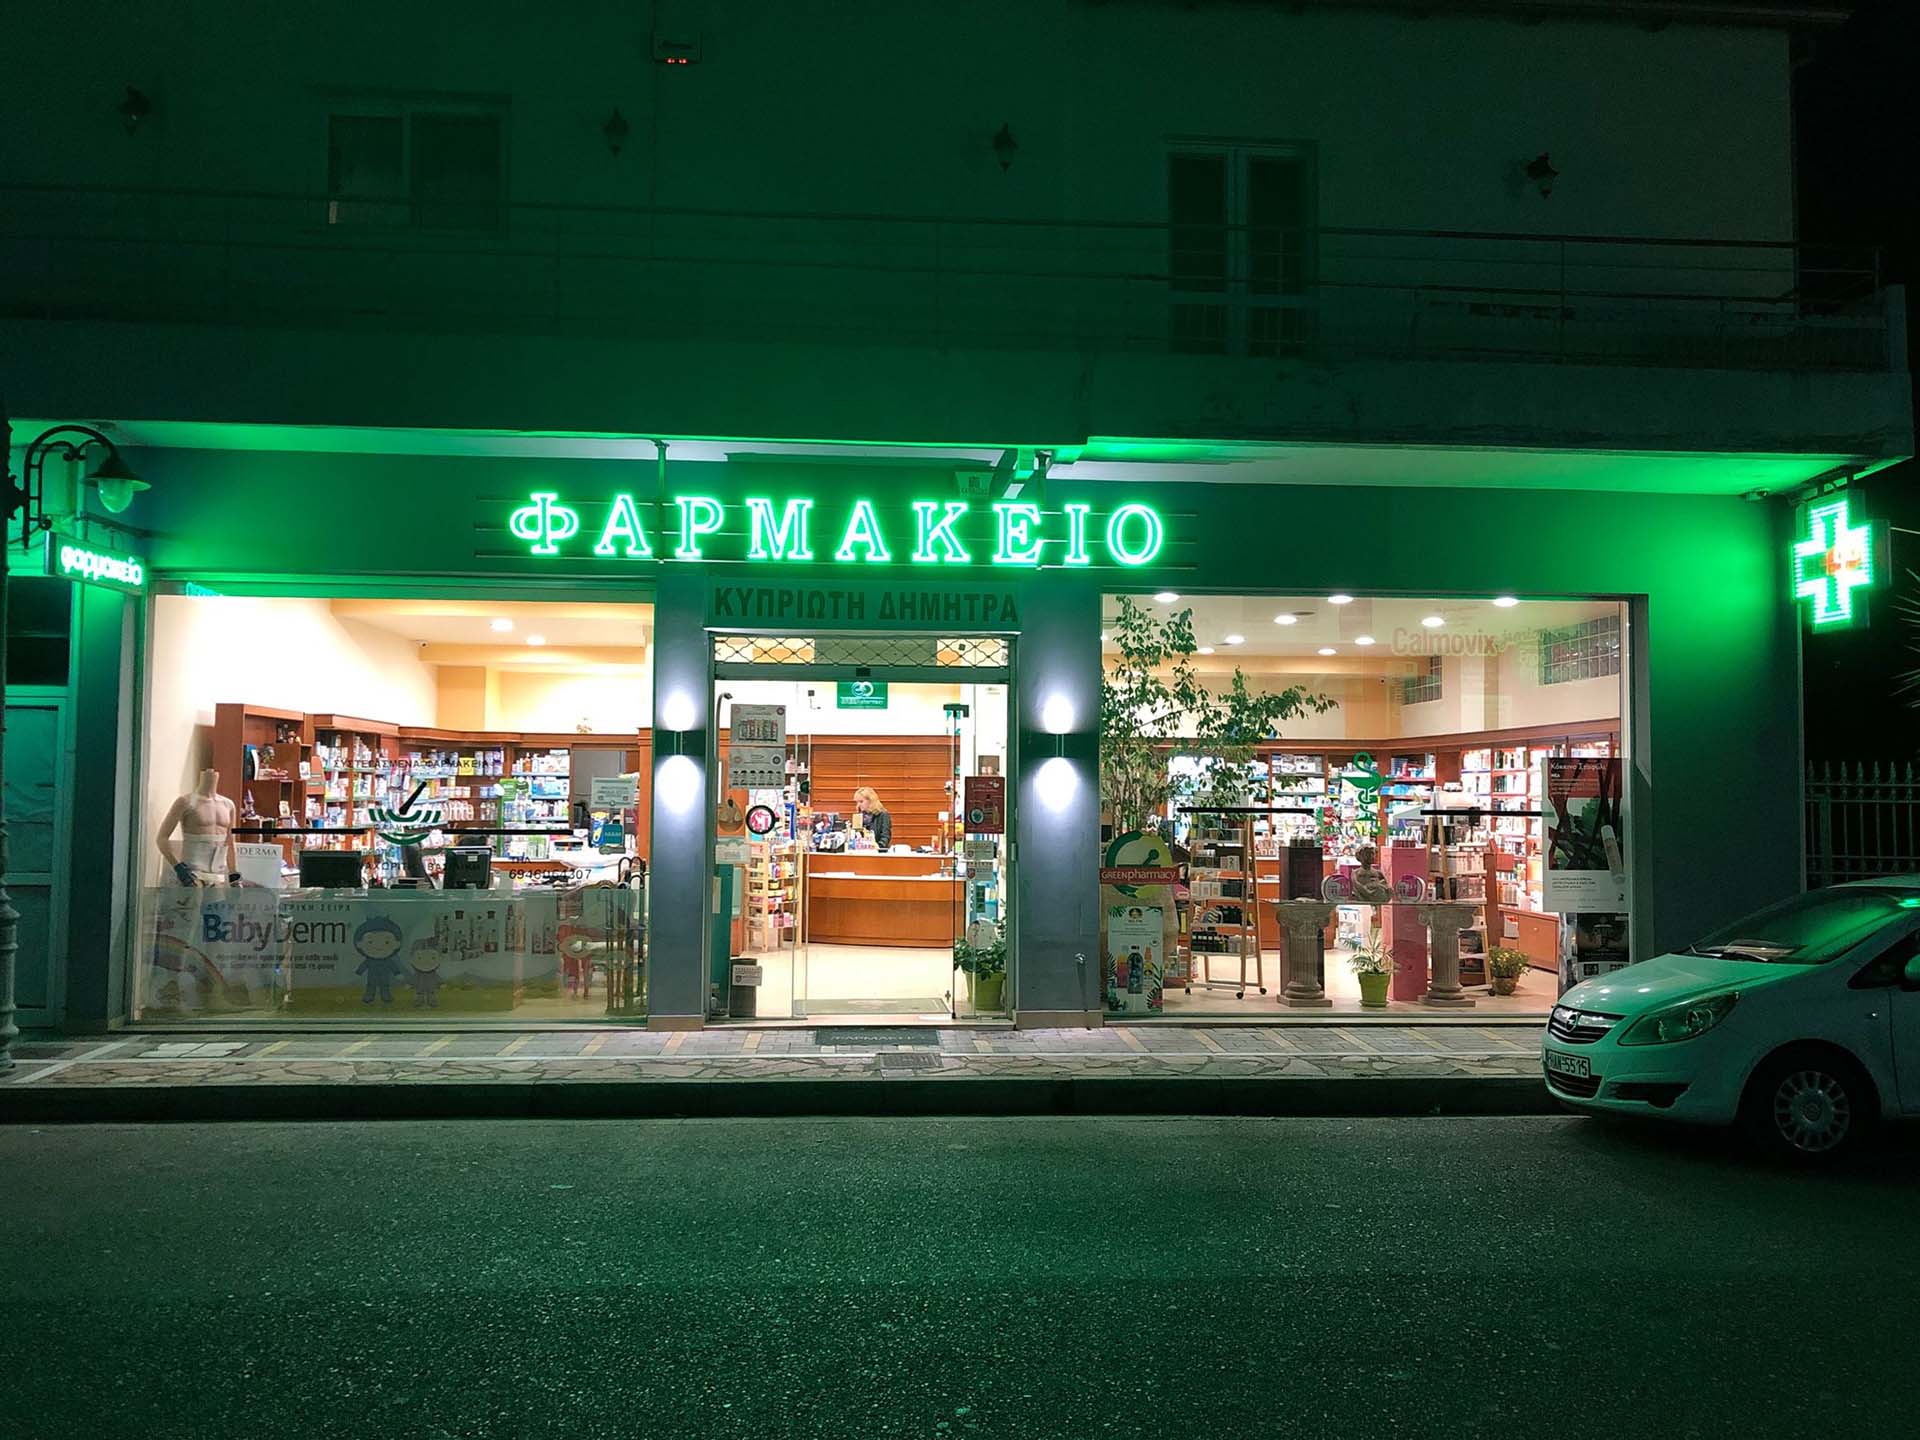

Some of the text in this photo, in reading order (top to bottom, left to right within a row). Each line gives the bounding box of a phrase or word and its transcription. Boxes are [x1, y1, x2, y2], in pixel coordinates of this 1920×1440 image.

[508, 491, 1164, 567] ΦΑΡΜΑΚΕΙΟ
[714, 586, 1019, 622] ΚΥΠΡΙΩΤΗ ΔΗΜΗΤΡΑ
[1392, 626, 1497, 656] Calmovix
[425, 759, 489, 768] ΦΑΡΜΑΚΕΙΑ
[1101, 868, 1177, 880] GREENpharmacy
[203, 913, 346, 951] BabyDerm
